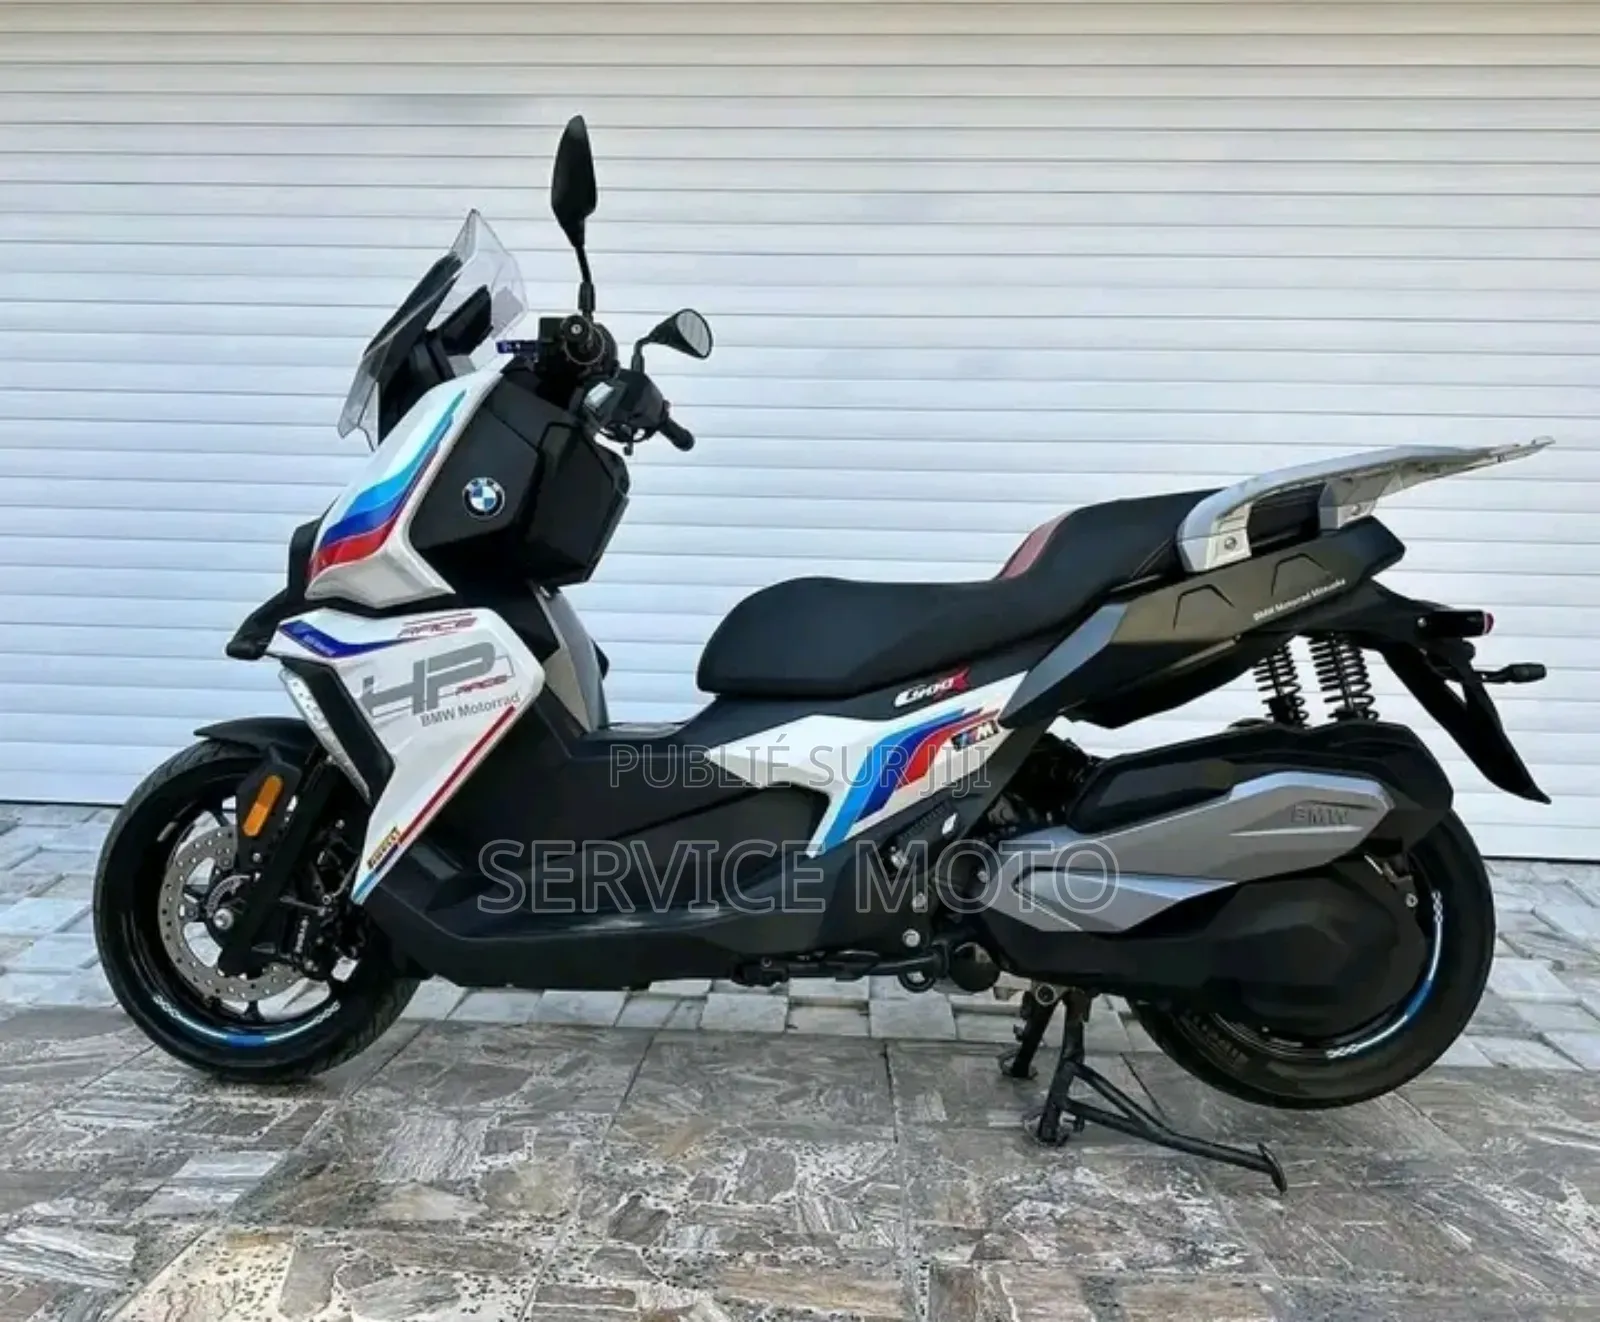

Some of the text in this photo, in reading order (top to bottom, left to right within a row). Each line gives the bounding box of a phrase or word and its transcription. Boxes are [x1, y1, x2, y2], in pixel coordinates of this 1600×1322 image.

[361, 642, 496, 715] HP
[420, 692, 520, 727] BMW Motorrad
[1291, 804, 1349, 825] BMW
